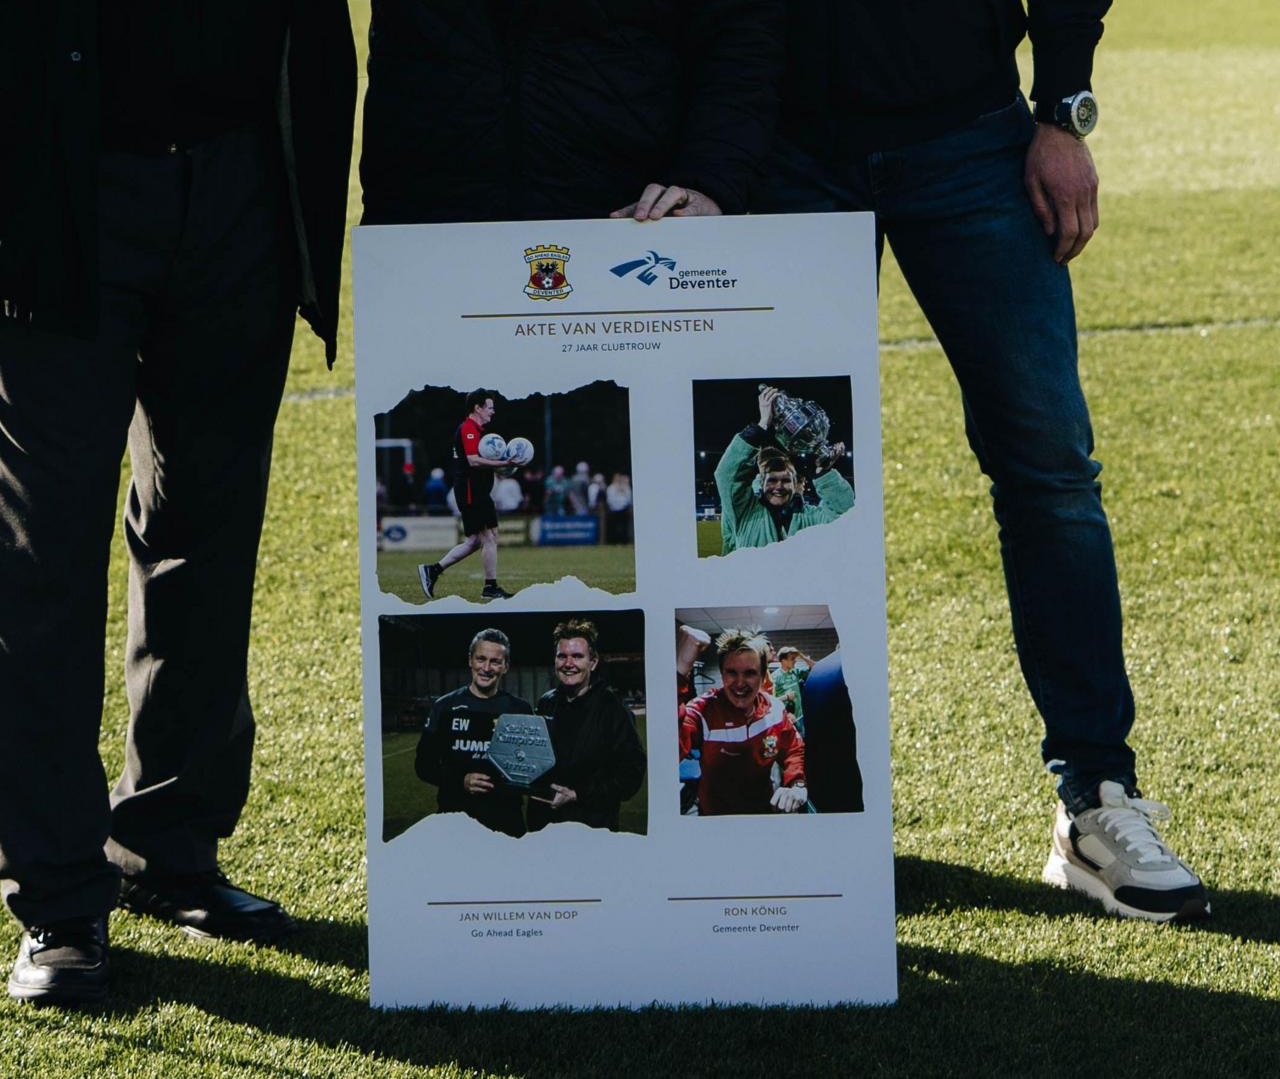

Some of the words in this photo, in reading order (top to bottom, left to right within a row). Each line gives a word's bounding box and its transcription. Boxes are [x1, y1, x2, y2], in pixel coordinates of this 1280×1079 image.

[678, 268, 728, 278] gemeente
[668, 275, 739, 290] Deventer
[514, 322, 557, 337] AKTE
[562, 321, 597, 336] VAN
[600, 319, 715, 335] VERDIENSTEN
[561, 344, 574, 353] 27
[575, 343, 599, 353] JAAR
[600, 341, 662, 352] CLUBTROUW
[451, 718, 471, 732] EW
[459, 912, 480, 922] JAN
[483, 911, 525, 921] WILLEM
[528, 911, 551, 920] VAN
[555, 910, 578, 920] DOP
[724, 907, 748, 917] RON
[751, 906, 787, 916] KÖNIG
[471, 929, 484, 938] Go
[486, 929, 513, 937] Ahead
[516, 928, 543, 938] Eagles
[712, 924, 757, 934] Gemeente
[759, 923, 800, 933] Deventer
